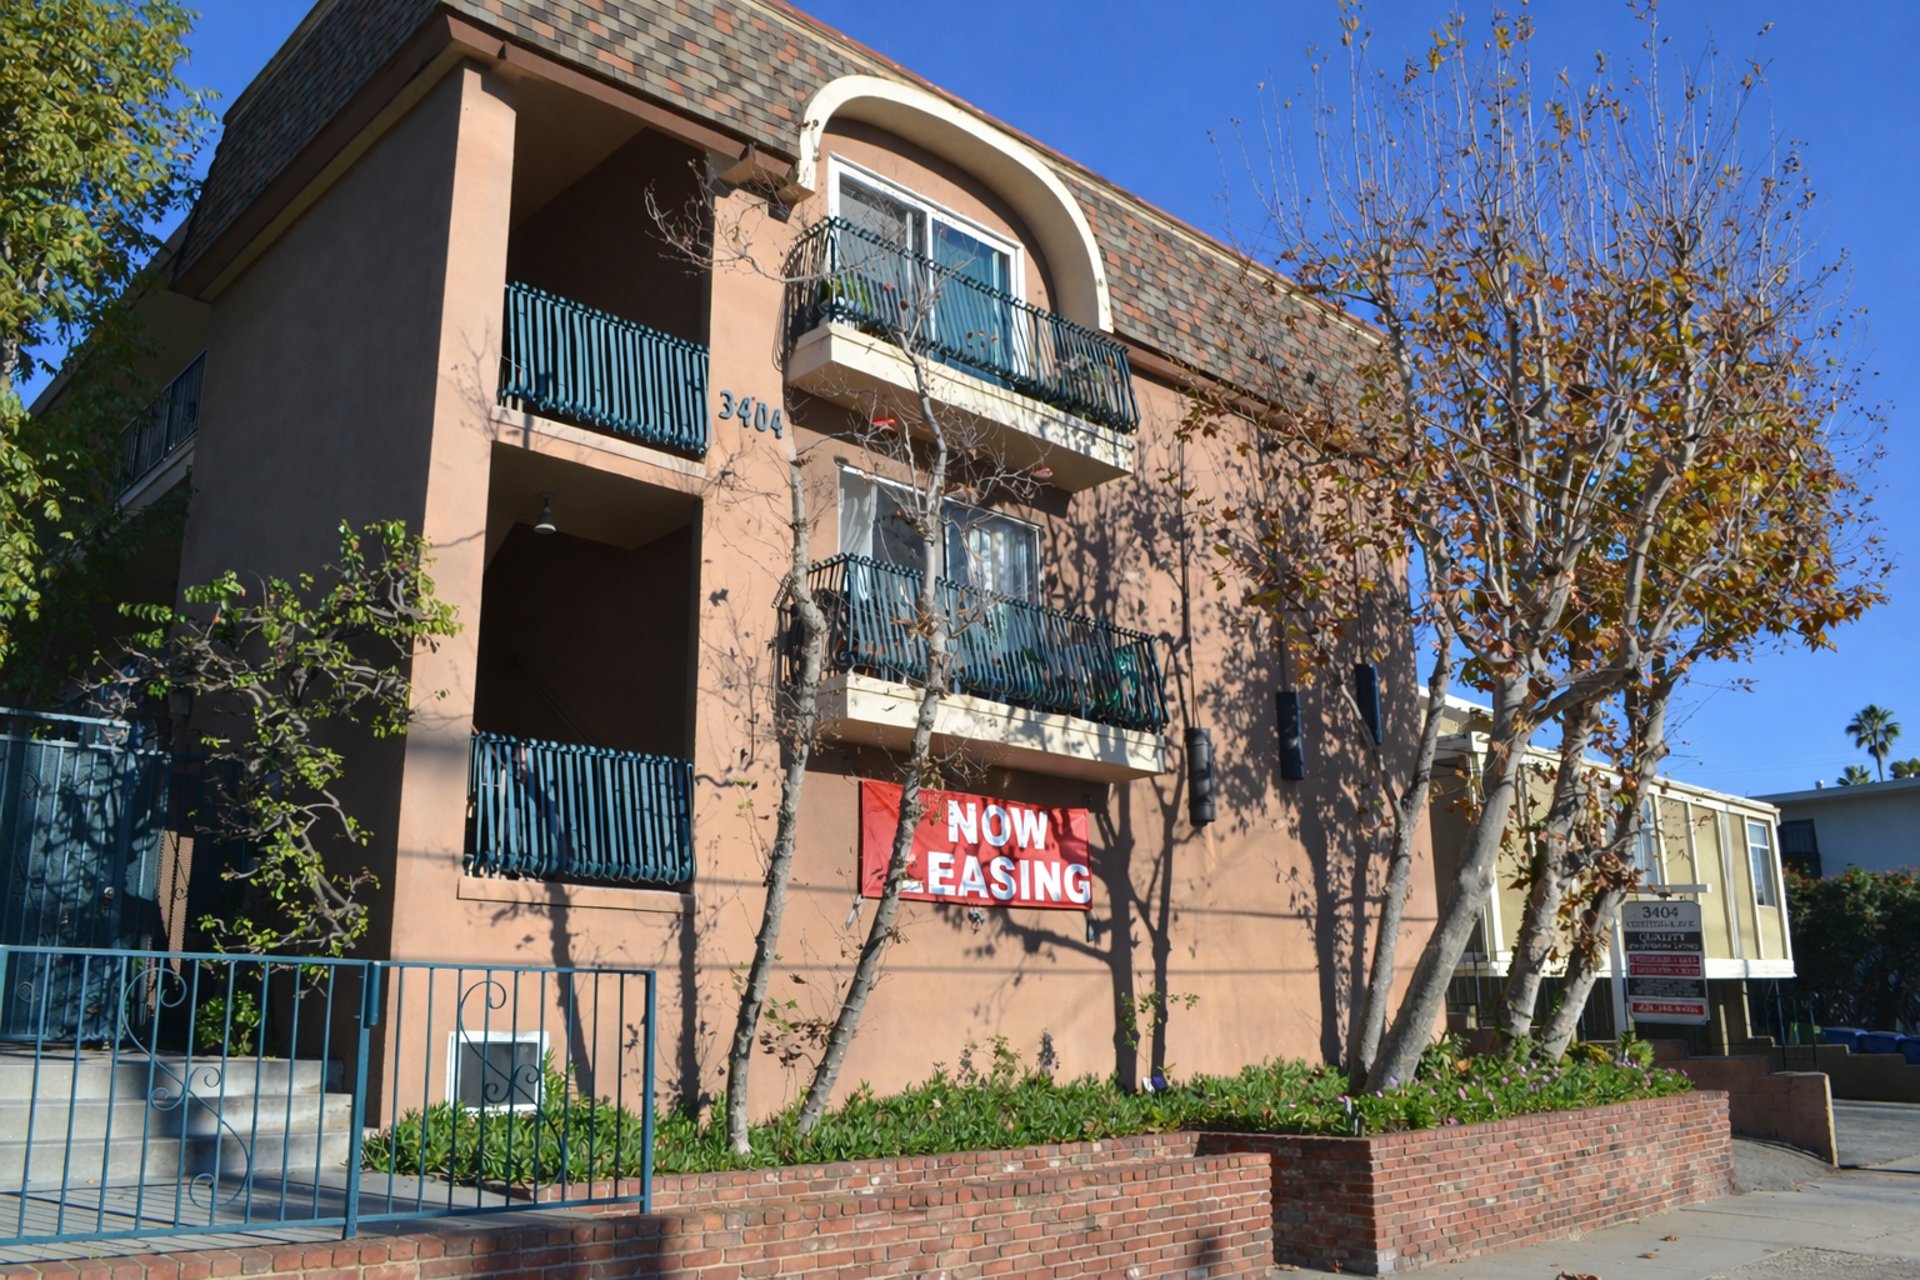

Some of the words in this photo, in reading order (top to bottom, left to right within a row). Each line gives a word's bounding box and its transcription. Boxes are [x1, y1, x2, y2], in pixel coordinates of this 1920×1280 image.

[718, 389, 783, 439] 3404
[947, 800, 1049, 849] NOW
[900, 850, 1091, 904] EASING
[1642, 906, 1679, 919] 3404
